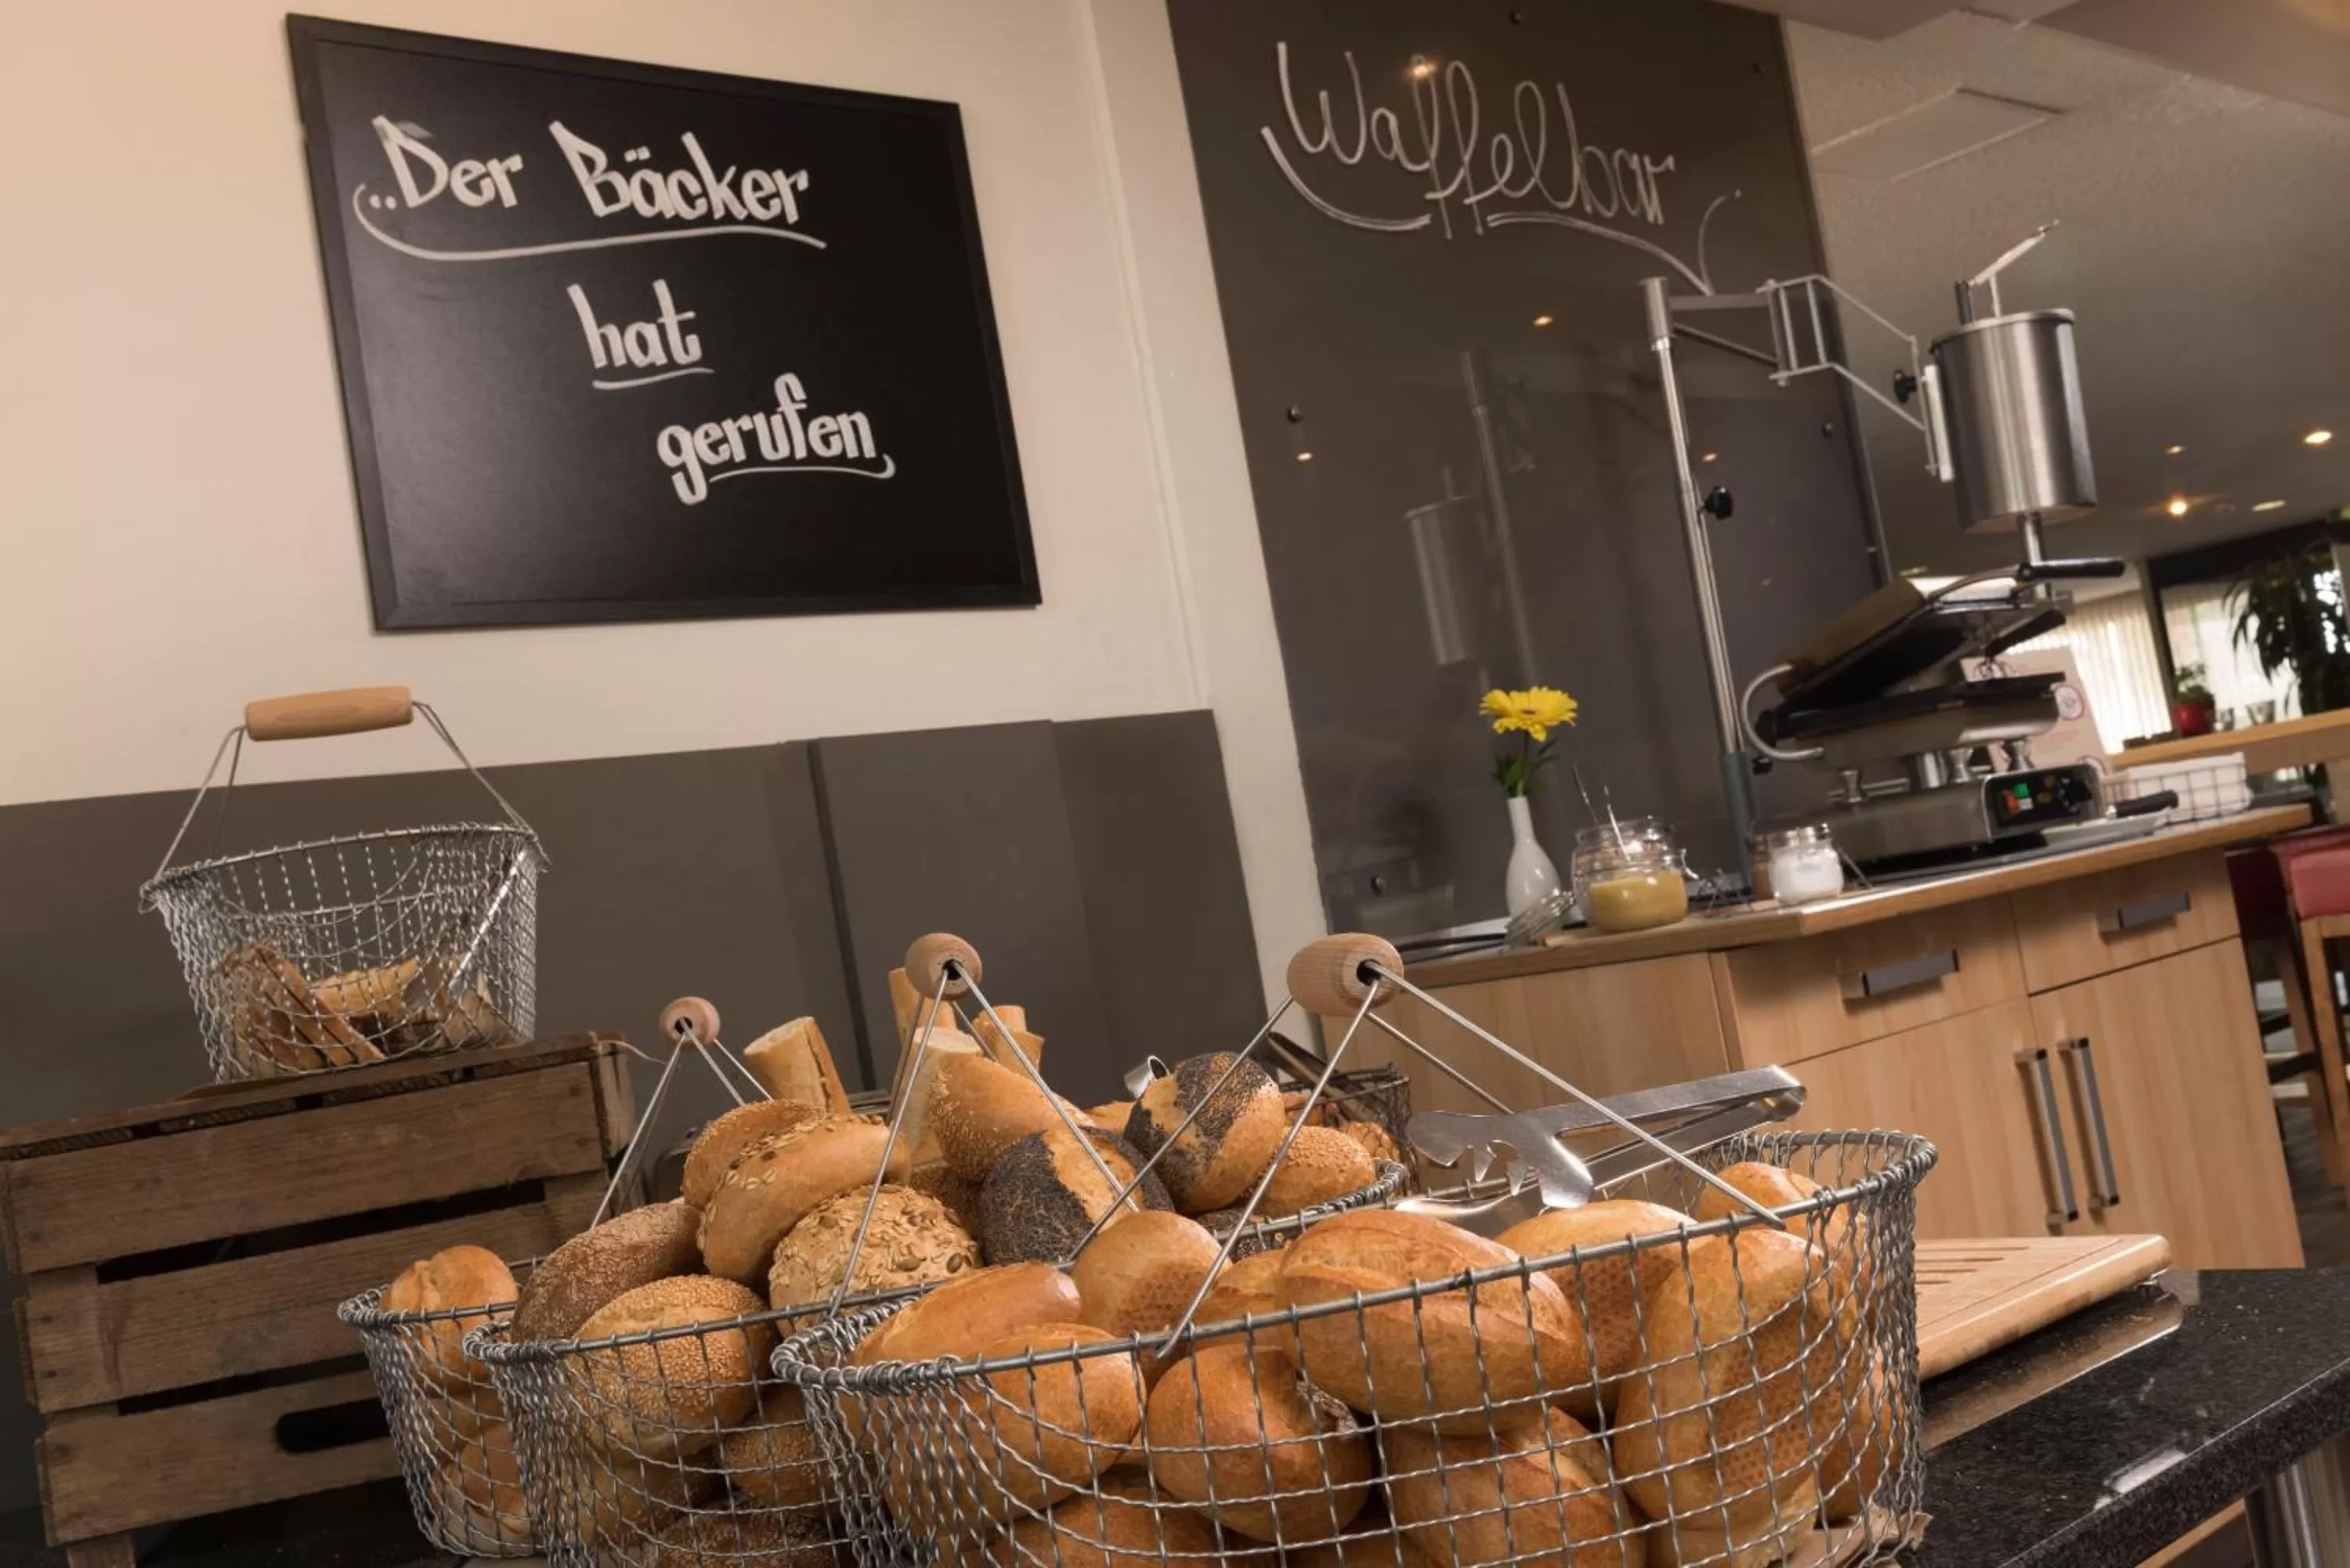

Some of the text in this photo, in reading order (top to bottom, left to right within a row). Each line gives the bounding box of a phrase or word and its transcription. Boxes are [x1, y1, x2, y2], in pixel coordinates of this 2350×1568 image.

[550, 121, 808, 224] Bäcker
[1277, 41, 1675, 240] Waffelbar
[567, 279, 703, 369] hat
[657, 373, 876, 505] gerufen
